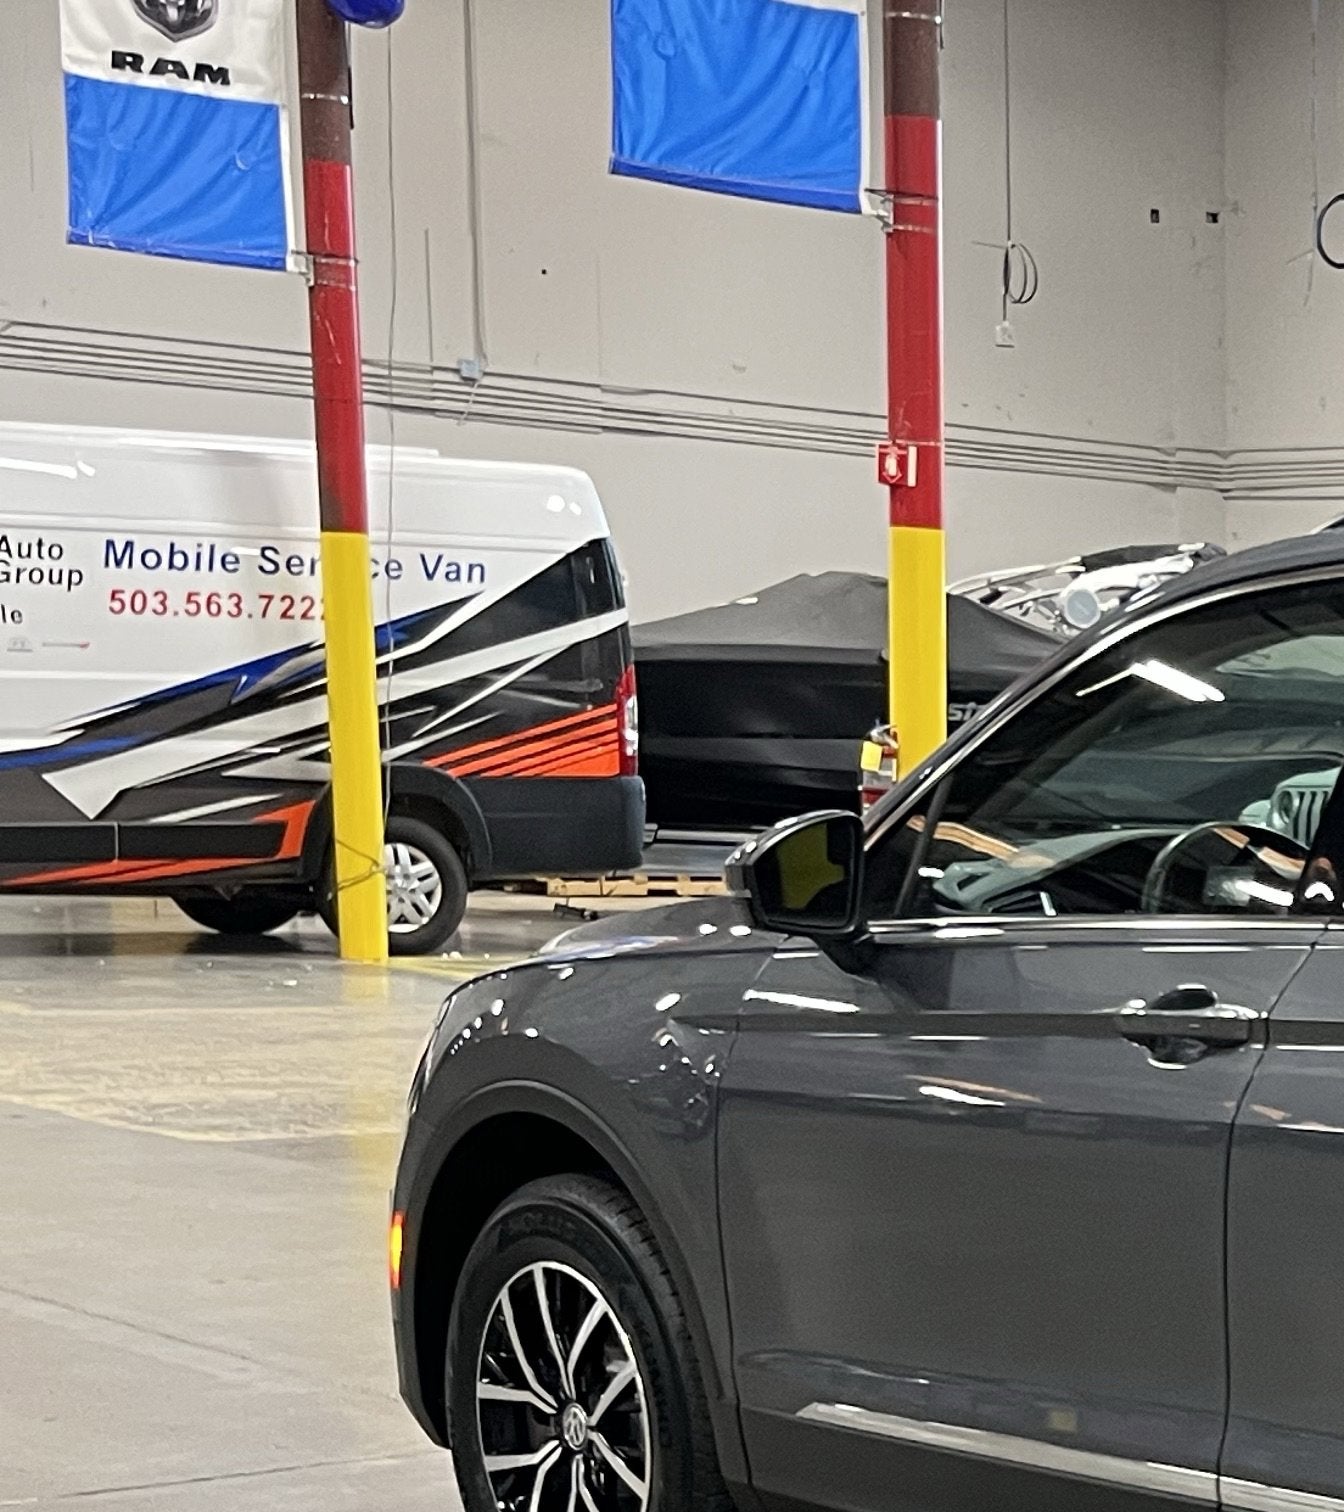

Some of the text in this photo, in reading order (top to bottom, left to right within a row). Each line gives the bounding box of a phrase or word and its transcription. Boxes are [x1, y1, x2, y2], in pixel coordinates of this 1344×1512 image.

[112, 50, 230, 85] RAM
[0, 534, 64, 561] Auto
[103, 538, 486, 584] Mobile Sere Van
[108, 588, 326, 621] 503.563.722
